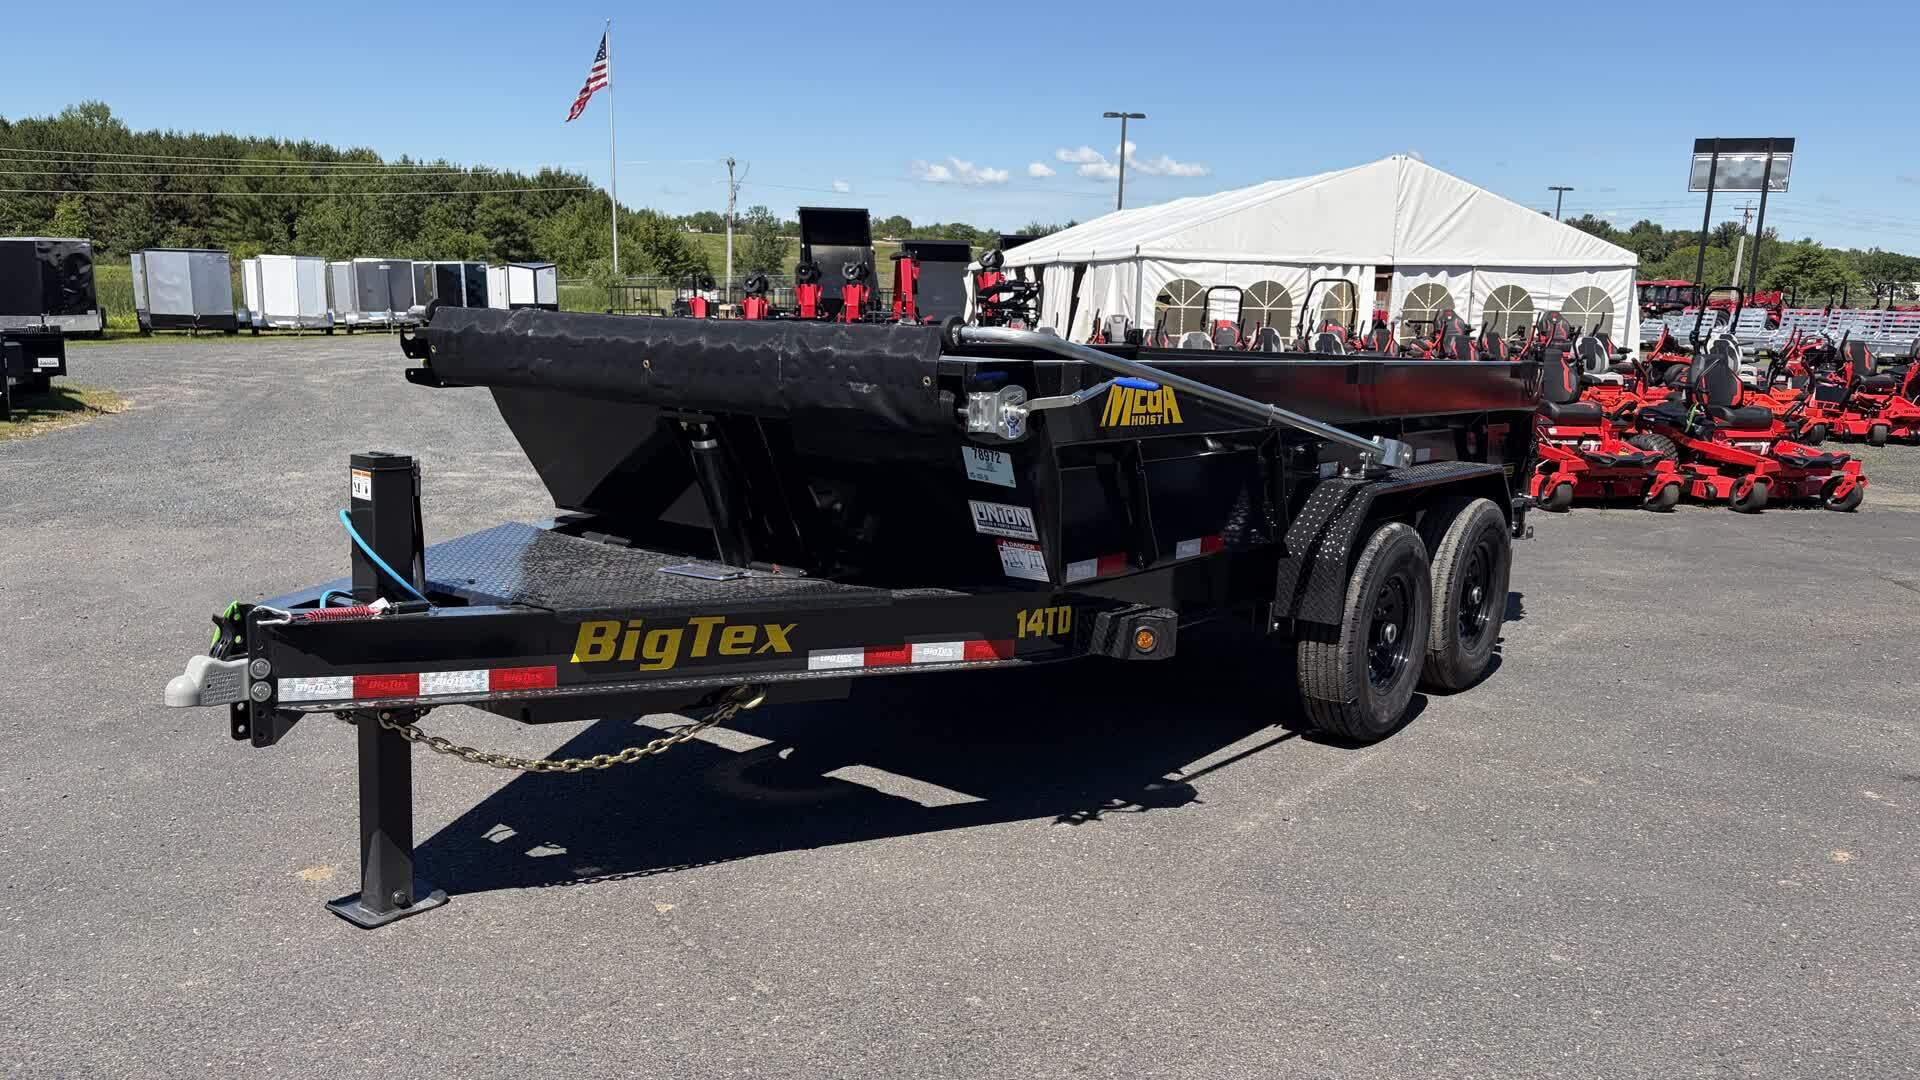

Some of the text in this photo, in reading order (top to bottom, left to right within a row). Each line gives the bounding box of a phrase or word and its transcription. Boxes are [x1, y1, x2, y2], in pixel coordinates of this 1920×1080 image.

[1100, 384, 1183, 426] MEGA
[1131, 415, 1162, 426] HOIST
[972, 447, 1001, 464] 78972
[1008, 541, 1035, 550] DANGER
[1017, 606, 1072, 638] 14TD
[570, 616, 798, 671] BigTex
